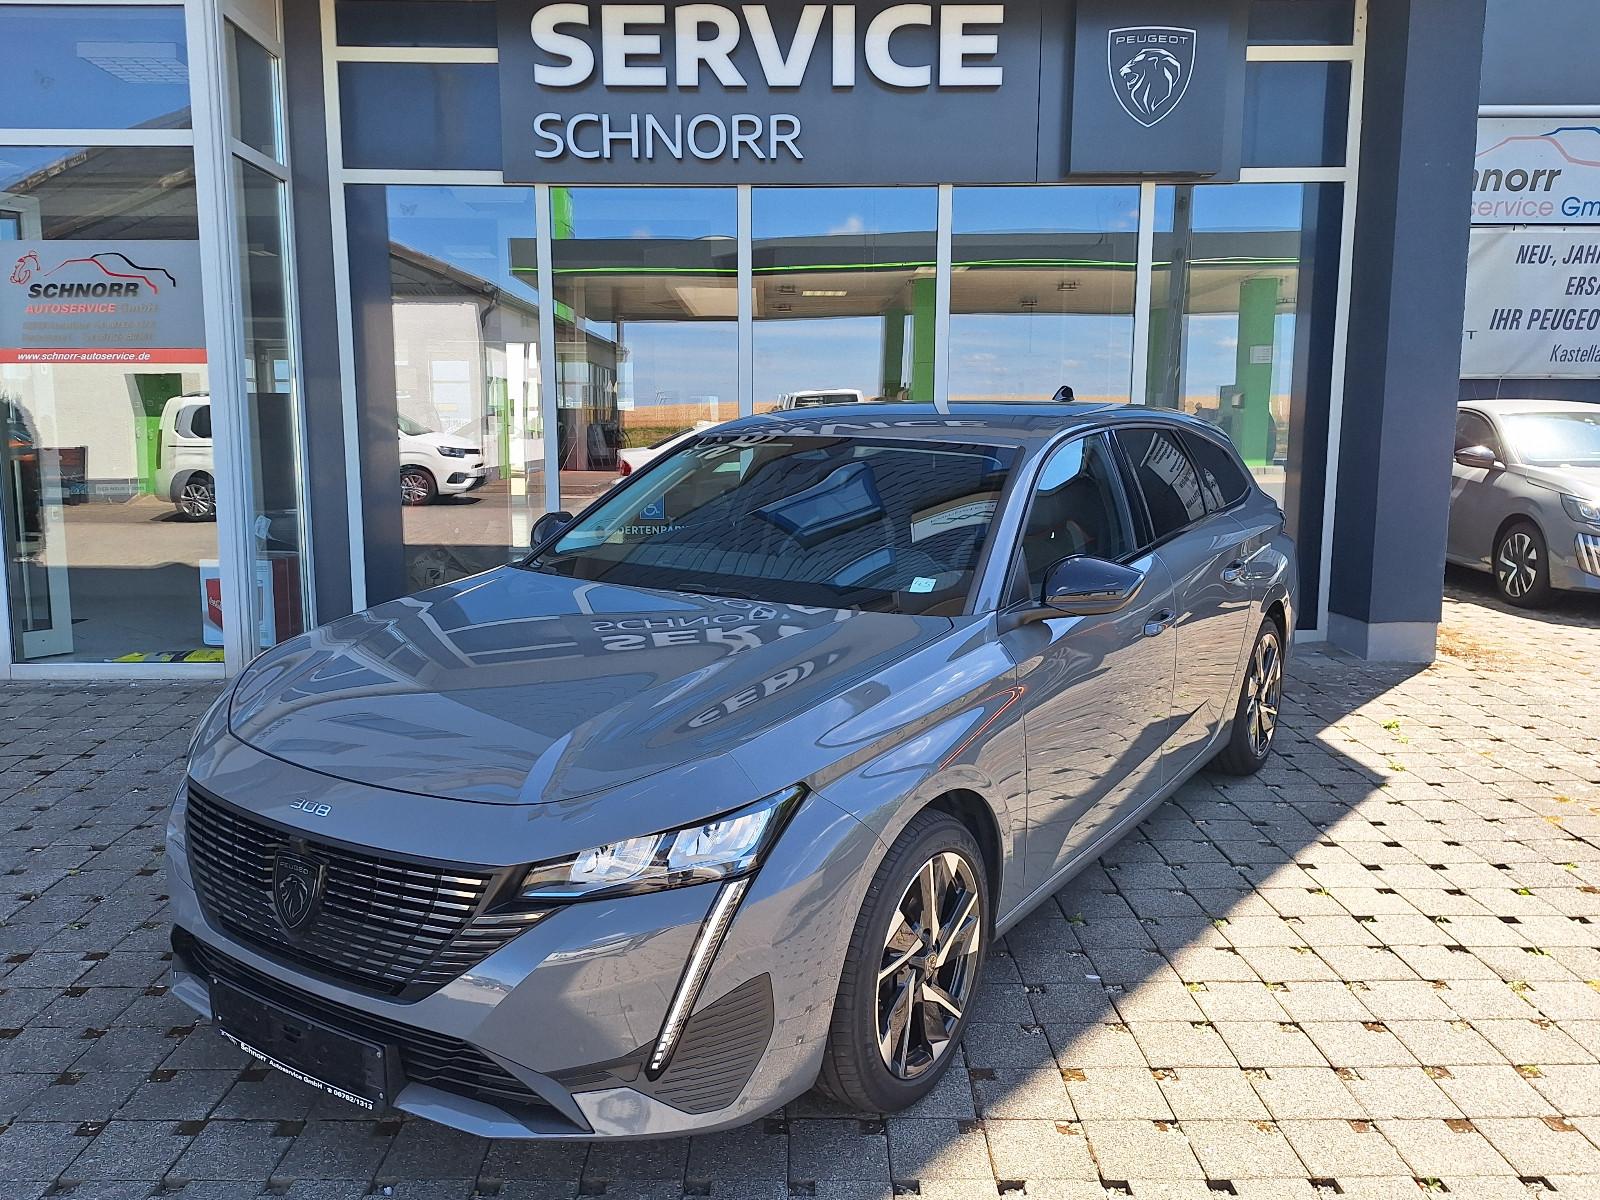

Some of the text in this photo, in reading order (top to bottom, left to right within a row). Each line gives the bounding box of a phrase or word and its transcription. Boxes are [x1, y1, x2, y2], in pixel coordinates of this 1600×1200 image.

[530, 3, 1004, 88] SERVICE
[1115, 34, 1189, 45] PEUGEOT
[532, 112, 805, 161] SCHNORR
[1515, 244, 1600, 266] NEU-, JAH
[28, 282, 140, 299] SCHNORR
[25, 303, 117, 315] AUTOSERVICE
[1489, 308, 1523, 331] IHR
[17, 351, 151, 361] www.schnorr-autoservice.de
[289, 797, 332, 817] 308
[279, 861, 312, 876] PEUGEO
[240, 1042, 267, 1063] Schnorr
[268, 1059, 303, 1081] Autoservice
[303, 1076, 323, 1091] GmbH
